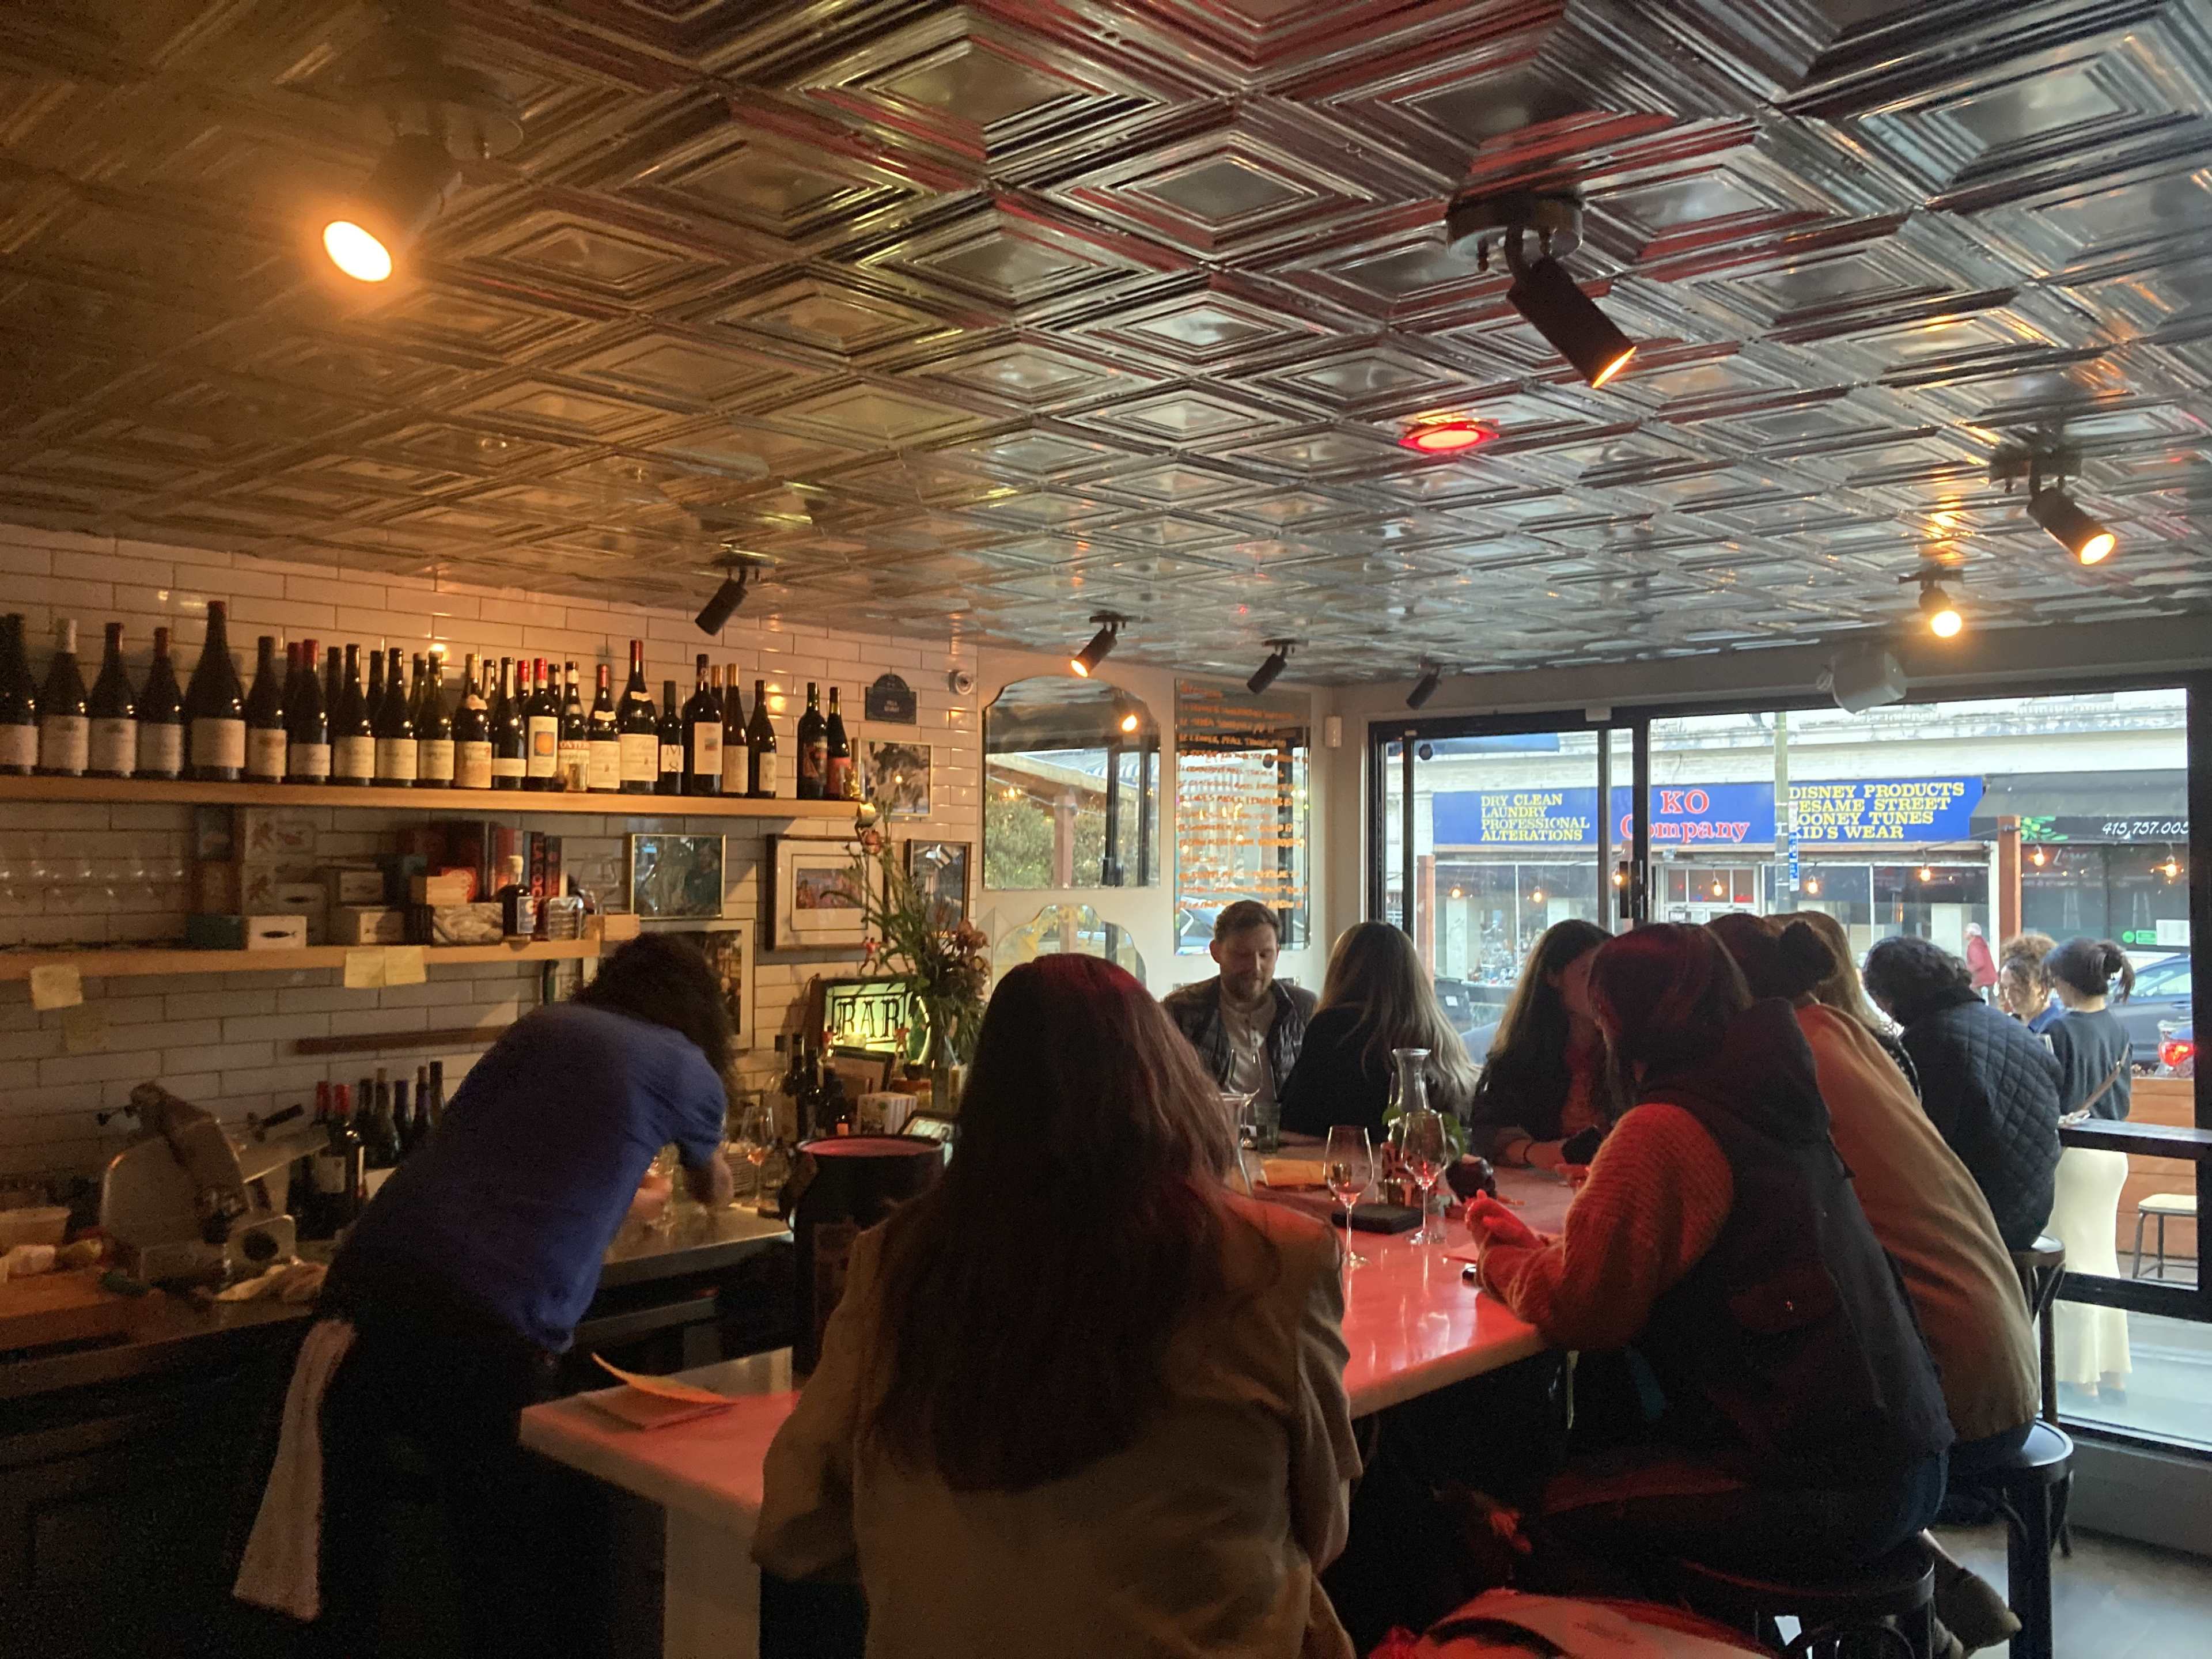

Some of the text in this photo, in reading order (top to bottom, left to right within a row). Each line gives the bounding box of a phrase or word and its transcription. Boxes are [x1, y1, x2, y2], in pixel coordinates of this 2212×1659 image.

[1789, 782, 1965, 800] DISNEY PRODUCTS
[1481, 793, 1563, 806] DRY CLEAN
[1660, 789, 1710, 814] KO
[1798, 797, 1950, 813] ESAME STREET
[1481, 806, 1548, 818] LAUNDRY
[1798, 810, 1934, 825] OONEY TUNES
[1481, 817, 1590, 830] PROFESSIONAL
[1480, 830, 1583, 841] ALTERATIONS
[1843, 825, 1904, 839] WEAR
